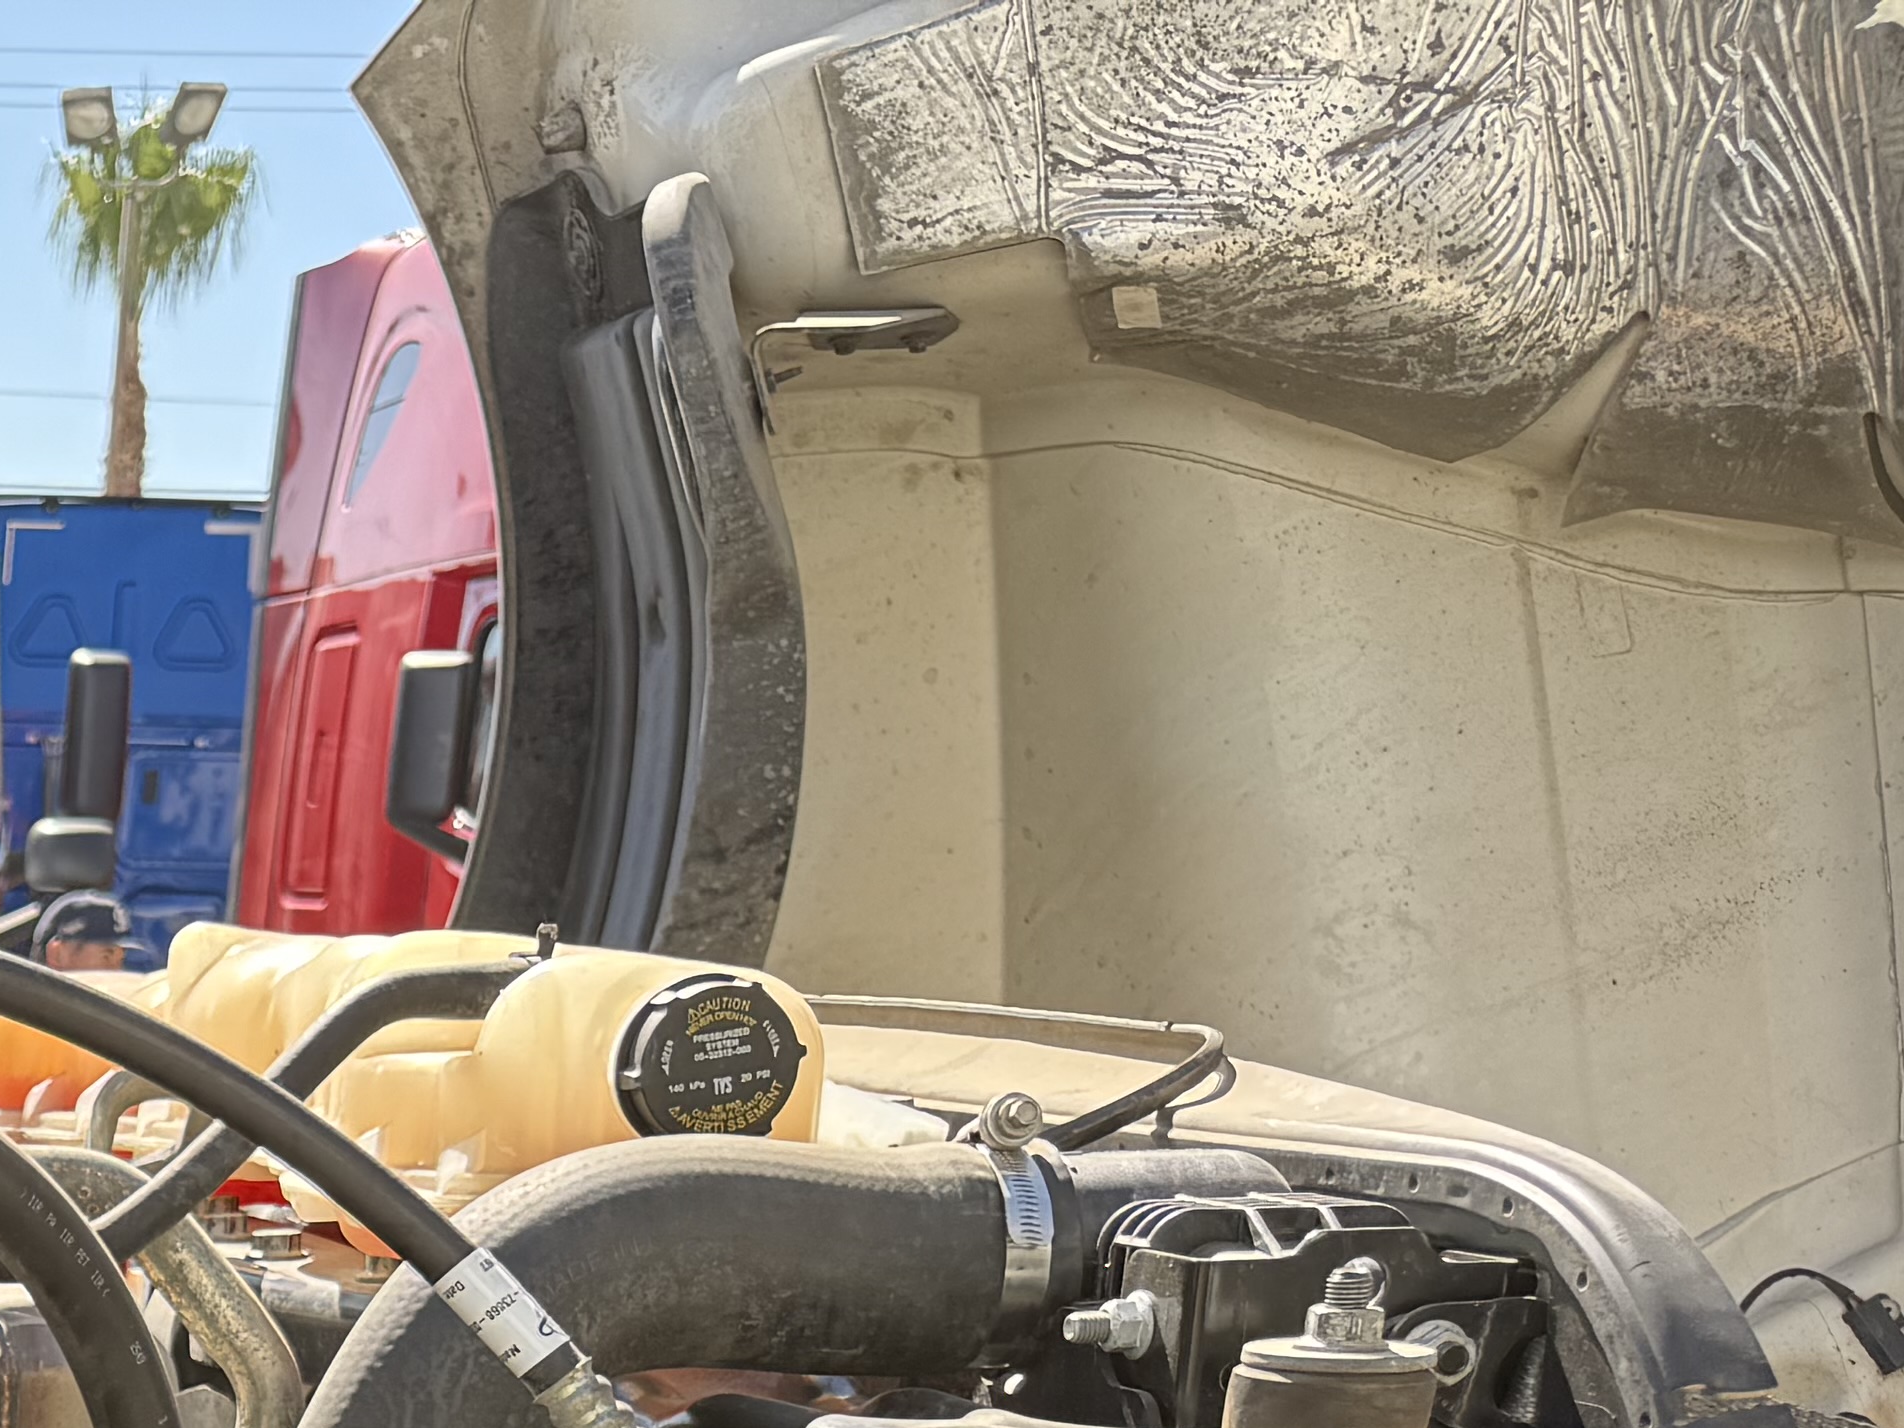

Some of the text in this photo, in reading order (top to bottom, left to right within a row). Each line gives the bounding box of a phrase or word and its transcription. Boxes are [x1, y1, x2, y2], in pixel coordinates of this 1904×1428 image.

[698, 996, 751, 1015] CAUTION
[693, 1026, 751, 1044] PRESSURIZED
[706, 1038, 740, 1051] SYSTEM
[713, 1076, 733, 1096] TVS
[676, 1079, 784, 1133] AVERTISSEMENT
